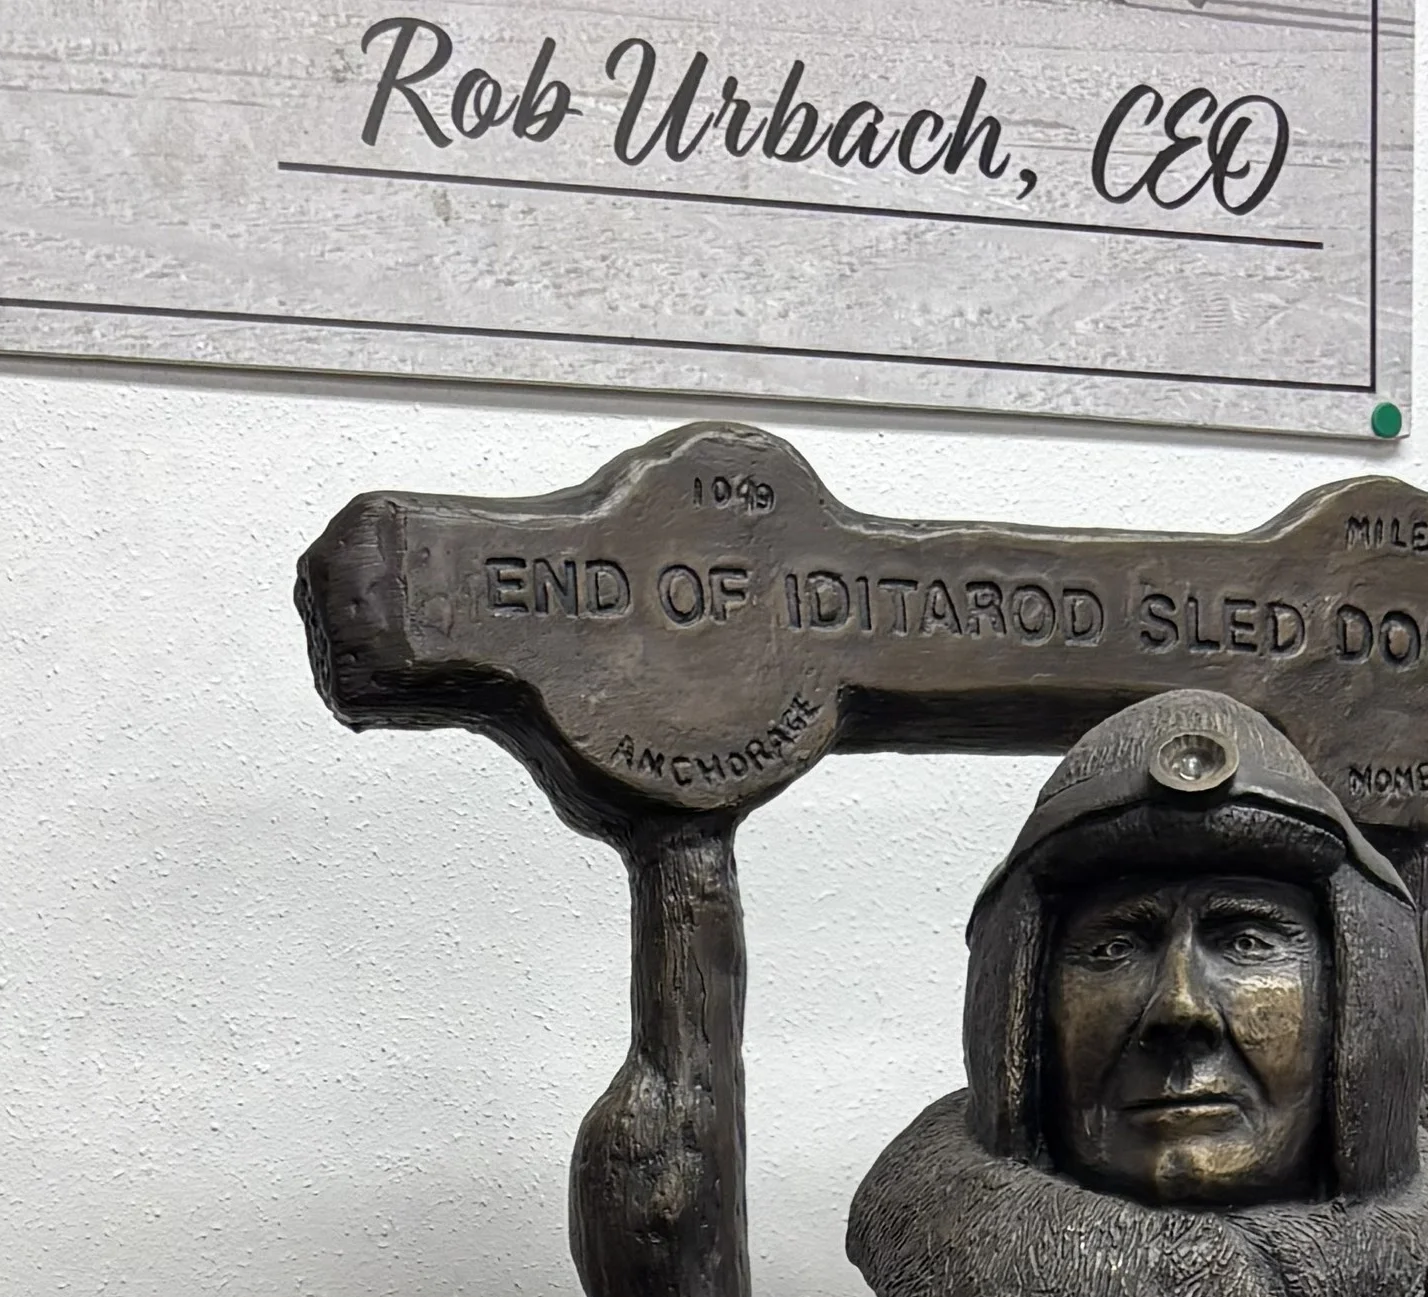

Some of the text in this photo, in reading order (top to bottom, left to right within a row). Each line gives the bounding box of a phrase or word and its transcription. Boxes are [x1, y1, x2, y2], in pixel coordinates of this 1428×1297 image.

[360, 17, 1290, 216] Rob Urbach, CEO
[484, 557, 632, 620] END
[655, 565, 752, 628] OF
[784, 571, 1105, 648] IDITAROD
[1139, 592, 1307, 660] SLED
[612, 695, 824, 788] ANCHORAGE
